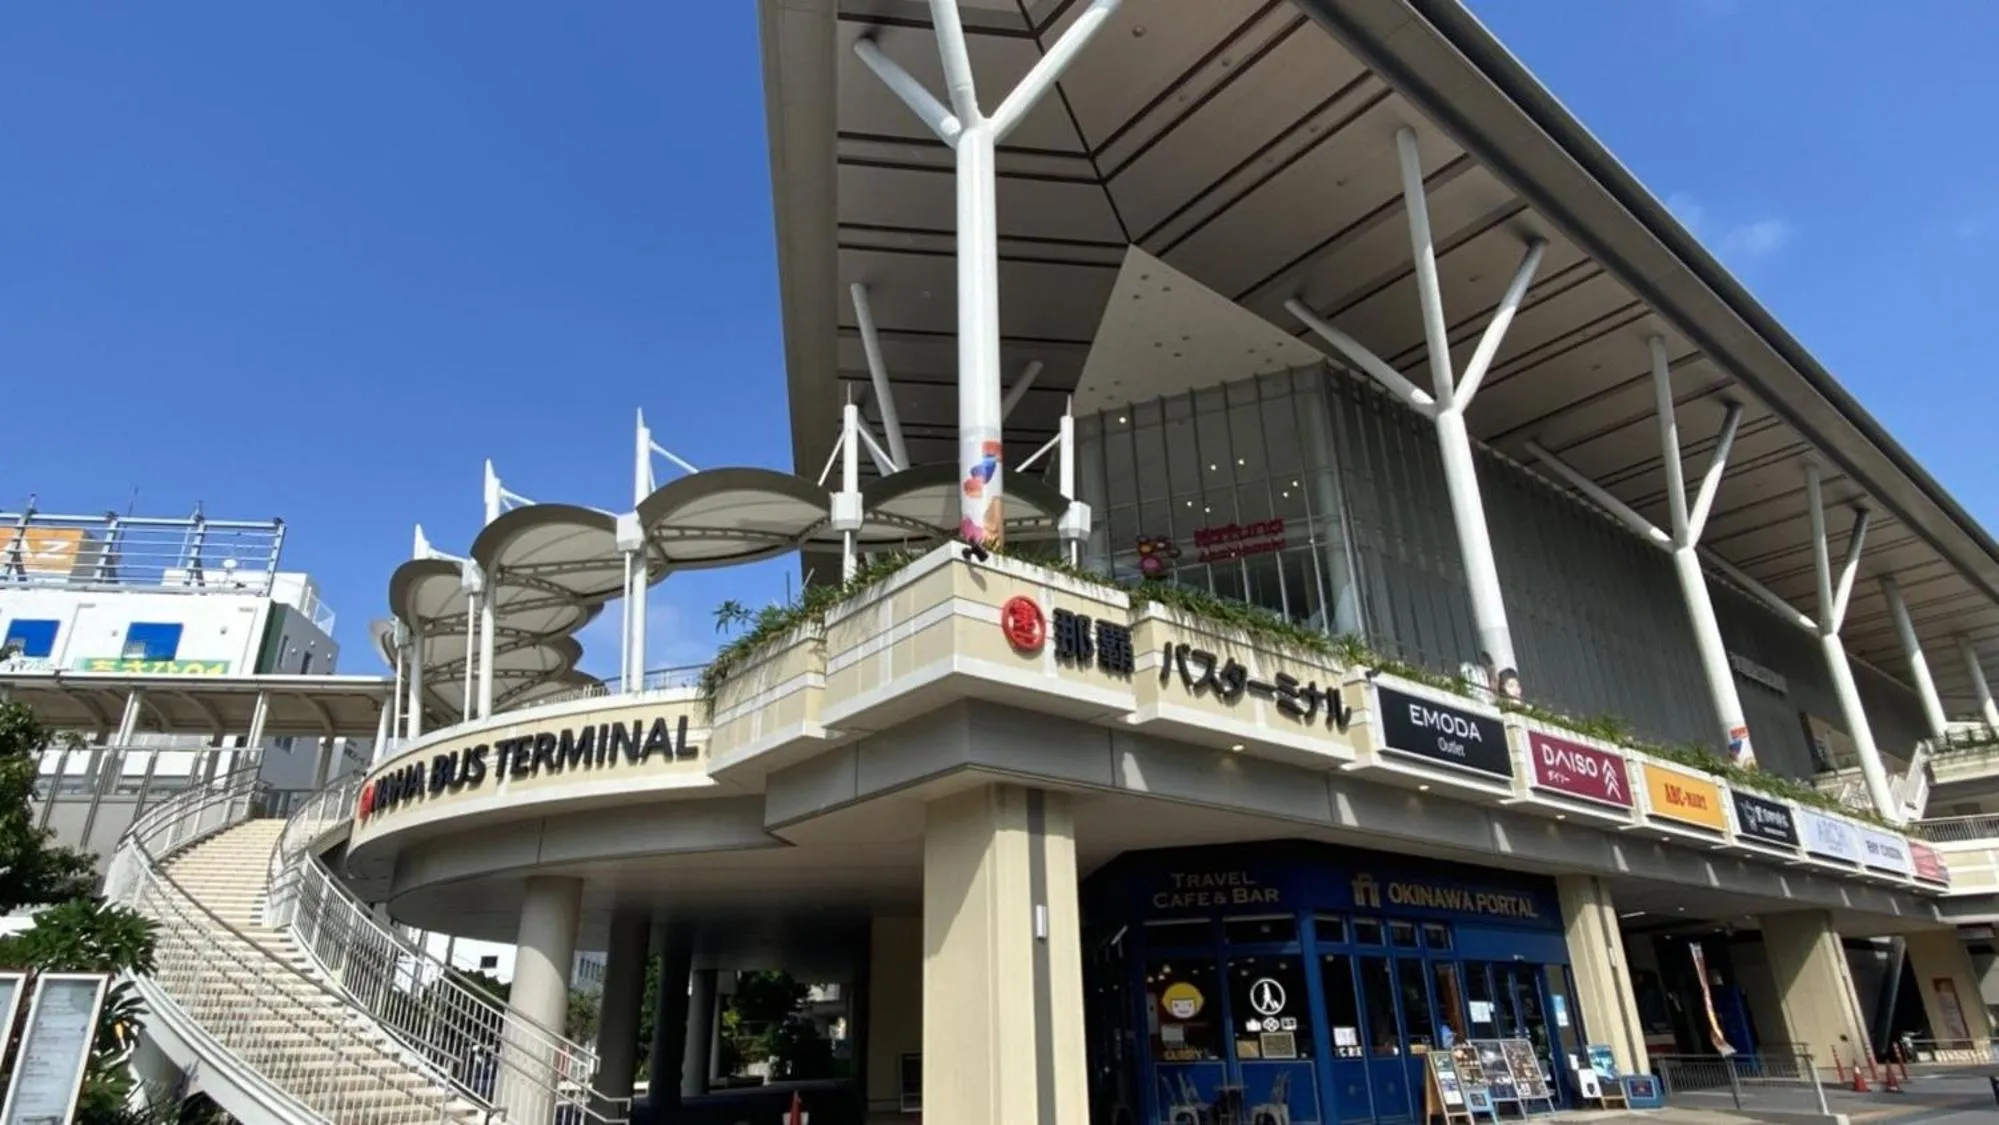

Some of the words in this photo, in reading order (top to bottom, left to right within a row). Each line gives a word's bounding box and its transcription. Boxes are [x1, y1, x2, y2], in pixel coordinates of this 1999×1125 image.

[1052, 608, 1135, 674] 那覇
[1160, 641, 1351, 731] バスターミナル
[1409, 703, 1482, 742] EMODA
[428, 744, 489, 793] BUS
[495, 715, 698, 778] TERMINAL
[1437, 736, 1466, 758] Outlet
[1541, 743, 1598, 778] DAISO
[1170, 870, 1257, 888] TRAVEL
[1152, 891, 1212, 908] CAFE
[1231, 887, 1280, 904] BAR
[1387, 882, 1474, 912] OKINAWA
[1476, 892, 1540, 919] PORTAL
